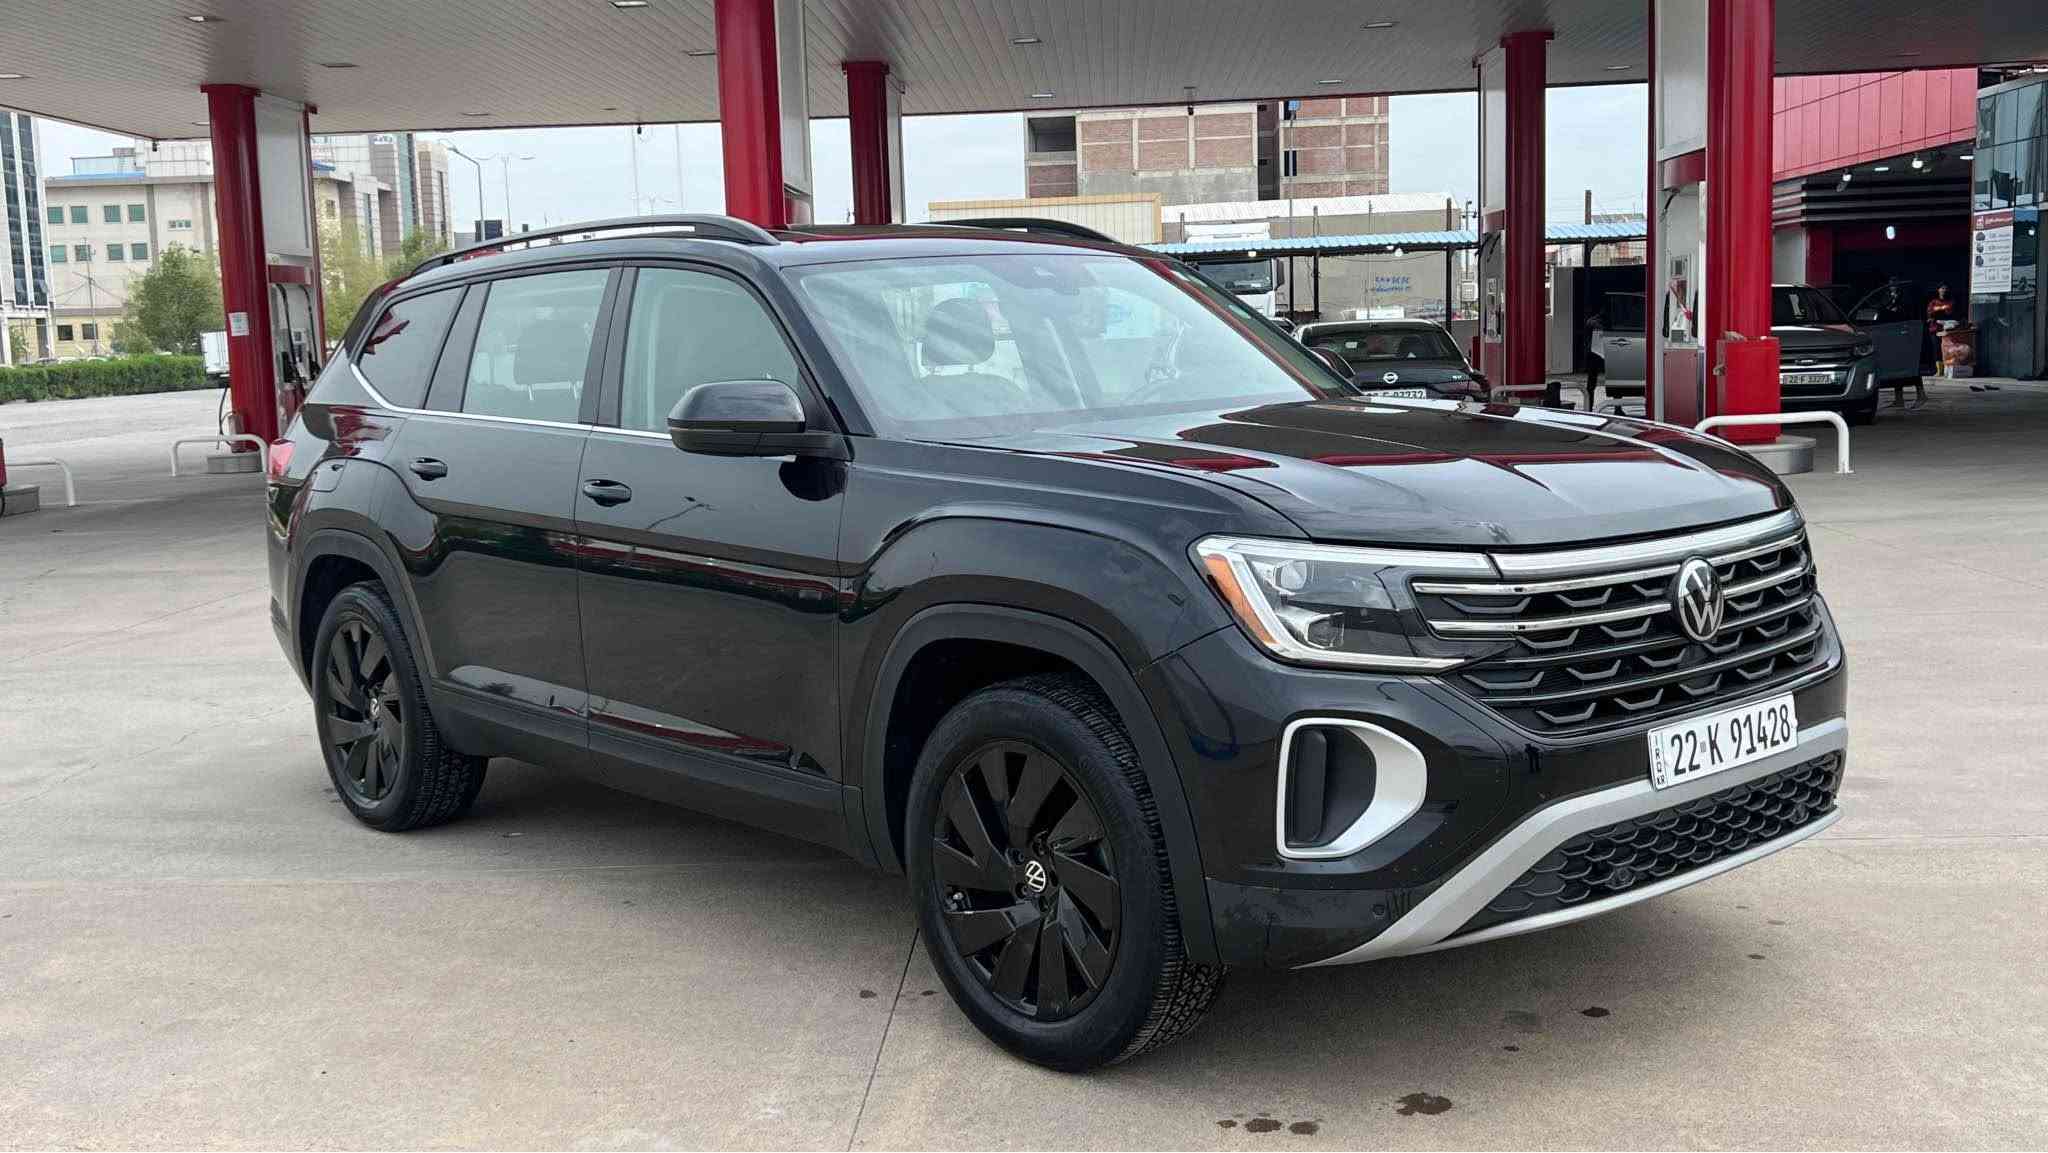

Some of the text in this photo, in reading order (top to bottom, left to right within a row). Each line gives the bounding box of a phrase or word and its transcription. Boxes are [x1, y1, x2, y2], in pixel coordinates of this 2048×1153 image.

[1671, 704, 1790, 776] 22 K 91428
